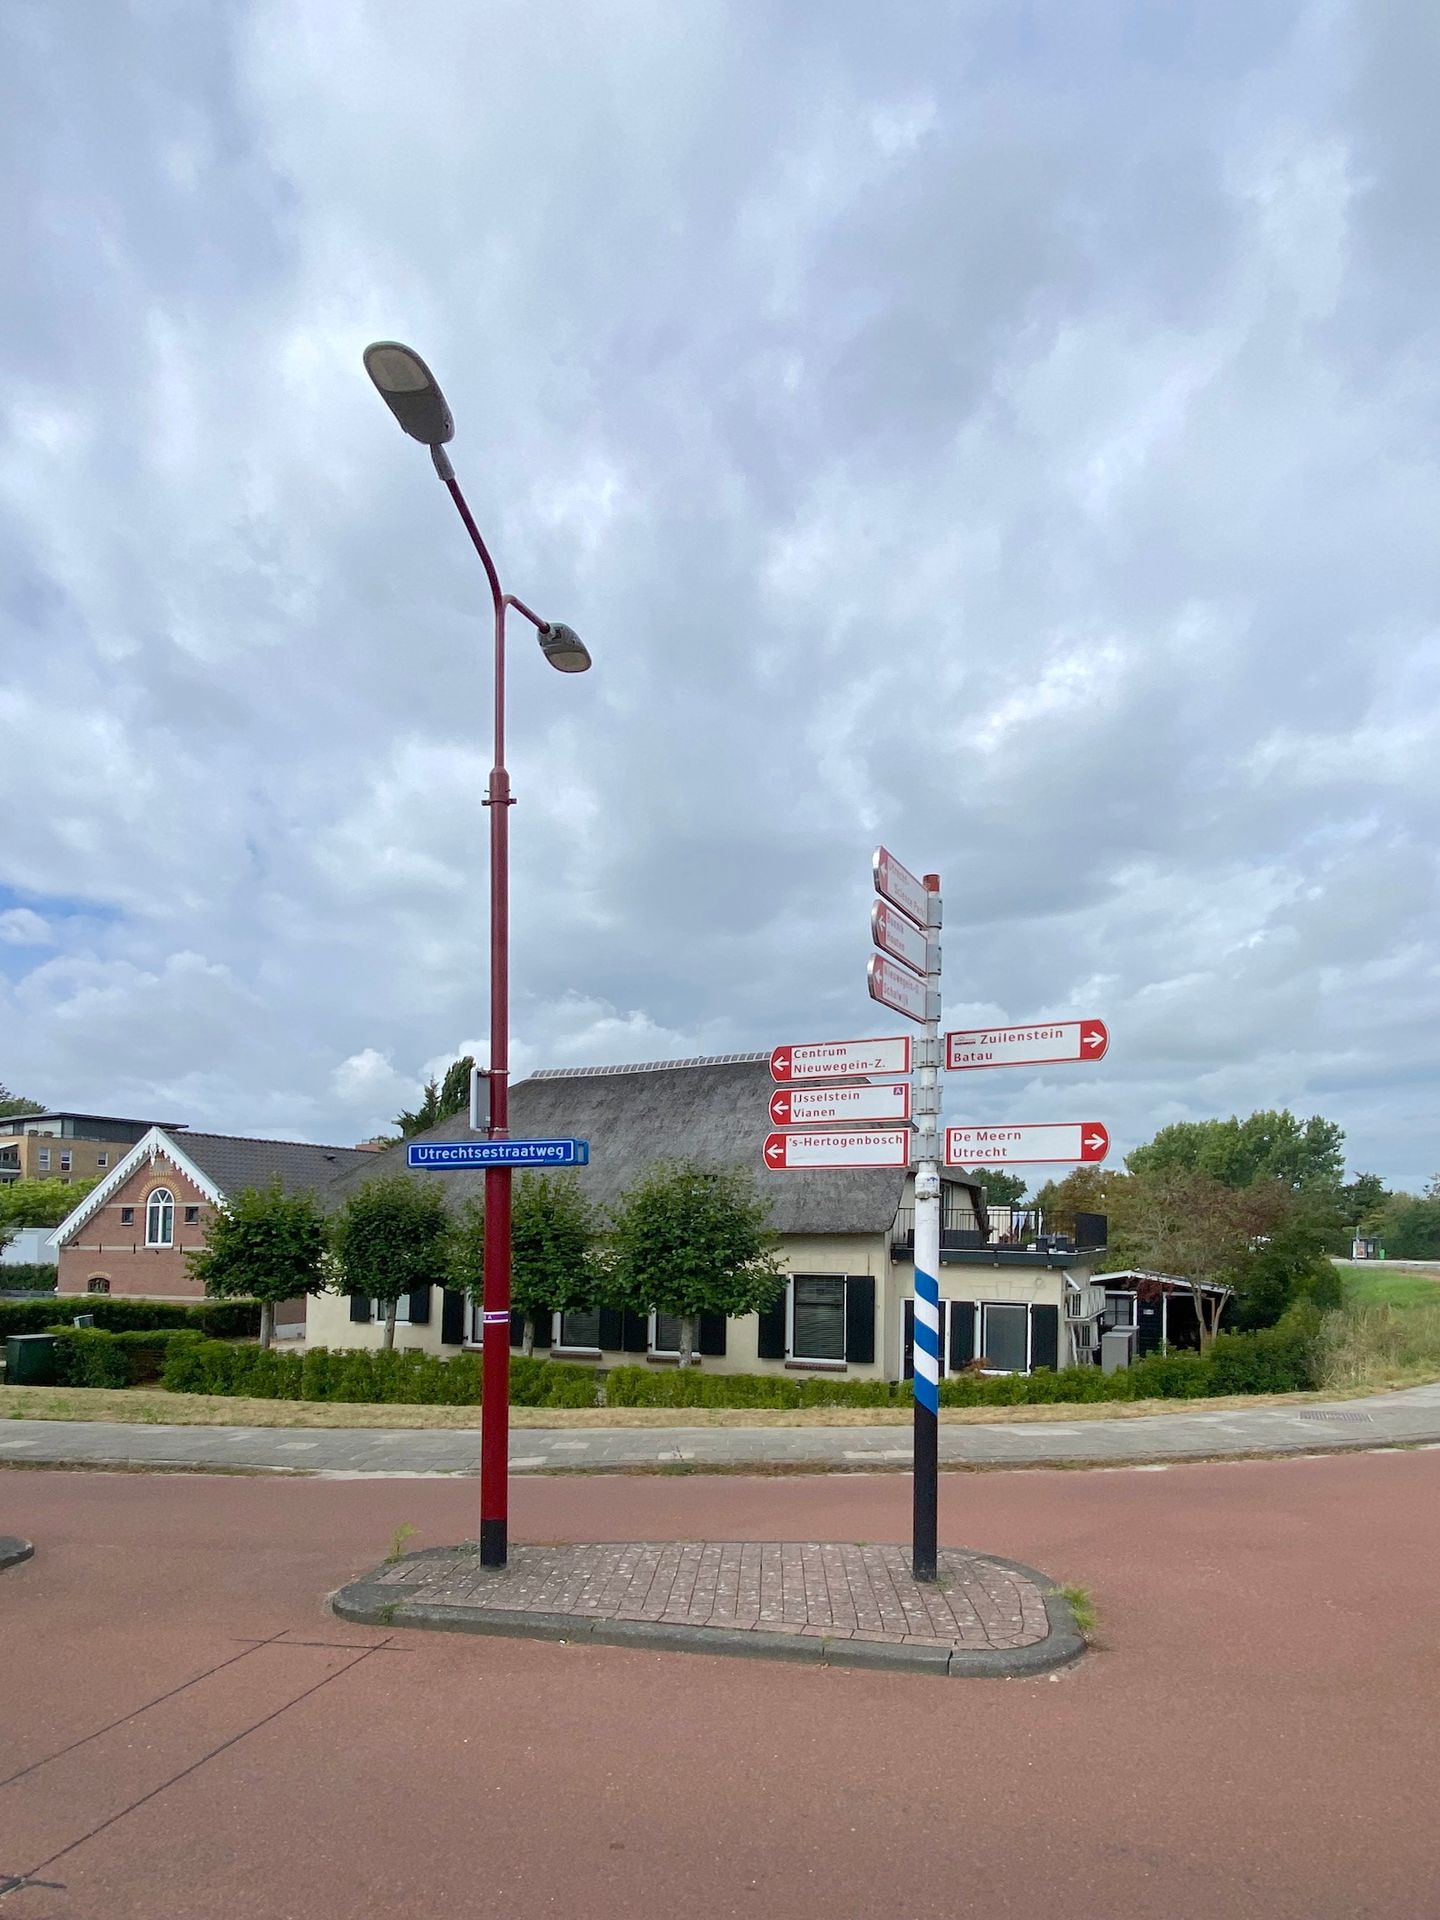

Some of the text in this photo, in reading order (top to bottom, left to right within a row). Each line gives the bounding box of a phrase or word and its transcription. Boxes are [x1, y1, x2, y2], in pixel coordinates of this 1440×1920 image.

[980, 1028, 1063, 1045] Zuilenstein
[793, 1047, 847, 1059] Centrum
[954, 1052, 993, 1063] Batau
[793, 1059, 886, 1074] Nieuwegein-Z.
[793, 1092, 860, 1103] IJsselstein
[793, 1108, 835, 1118] Vianen
[789, 1135, 902, 1148] 's-Hertogenbosch
[953, 1131, 1021, 1142] De Meern
[418, 1145, 564, 1160] Utrechtsestraatweg
[953, 1147, 1007, 1158] Utrecht
